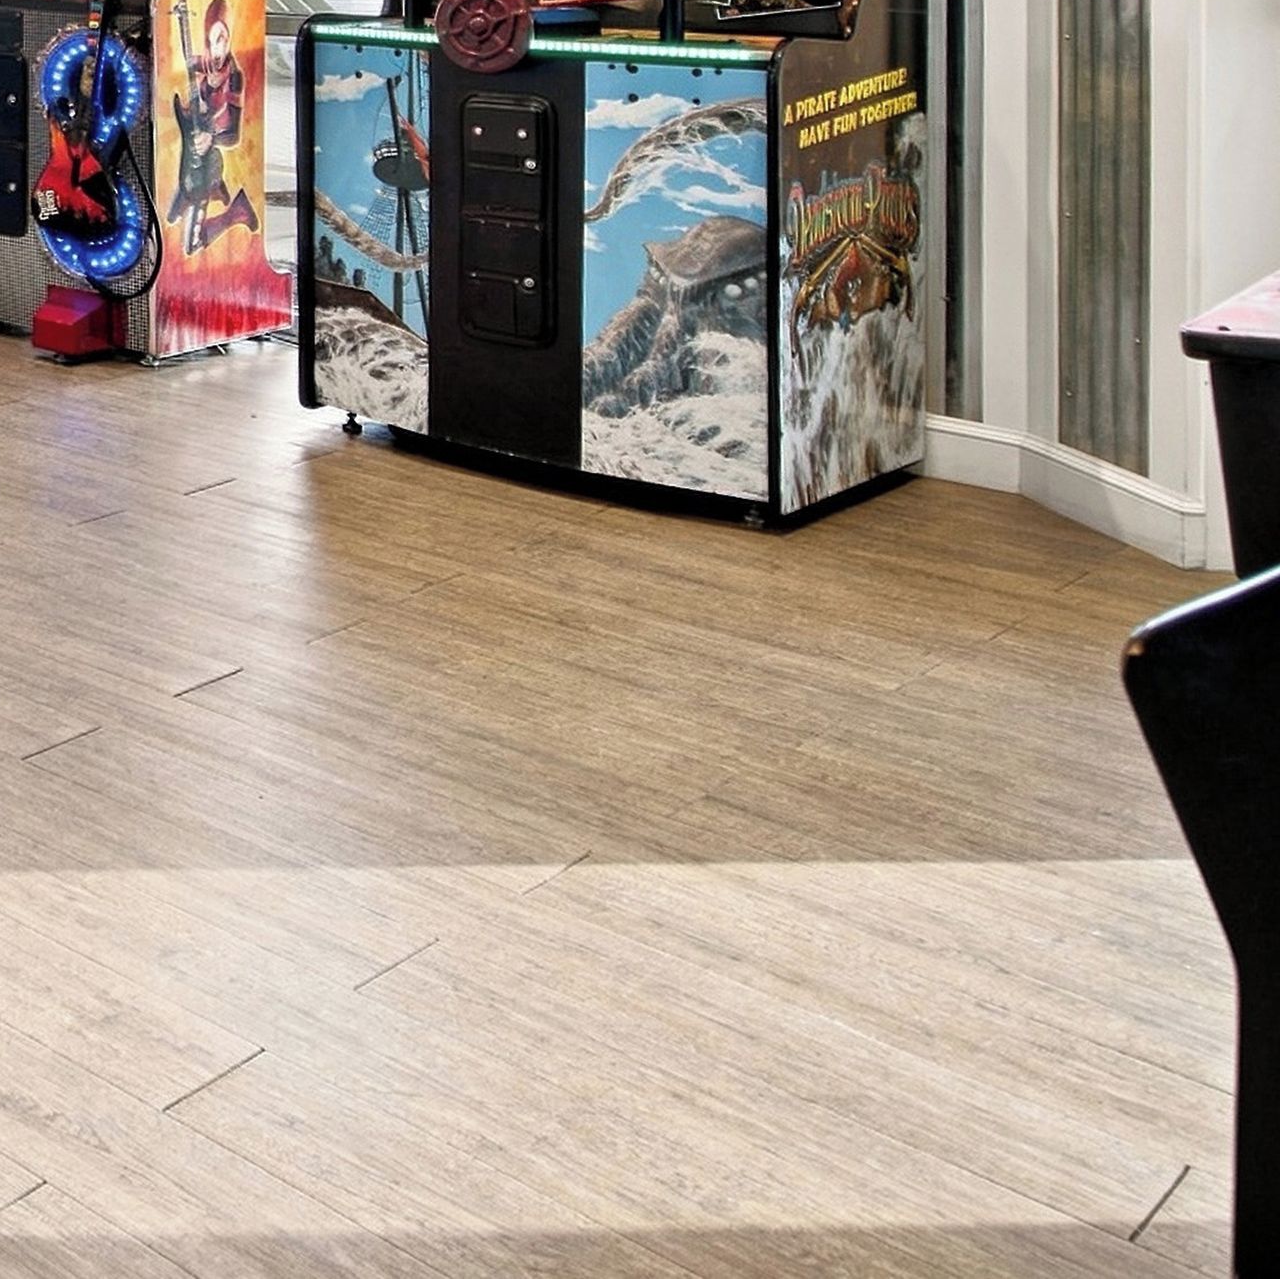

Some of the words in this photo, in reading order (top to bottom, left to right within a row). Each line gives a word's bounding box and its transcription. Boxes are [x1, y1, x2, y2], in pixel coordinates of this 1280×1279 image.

[784, 104, 794, 126] A
[796, 90, 838, 122] PIRATE
[799, 120, 831, 149] HAVE
[833, 111, 858, 137] FUN
